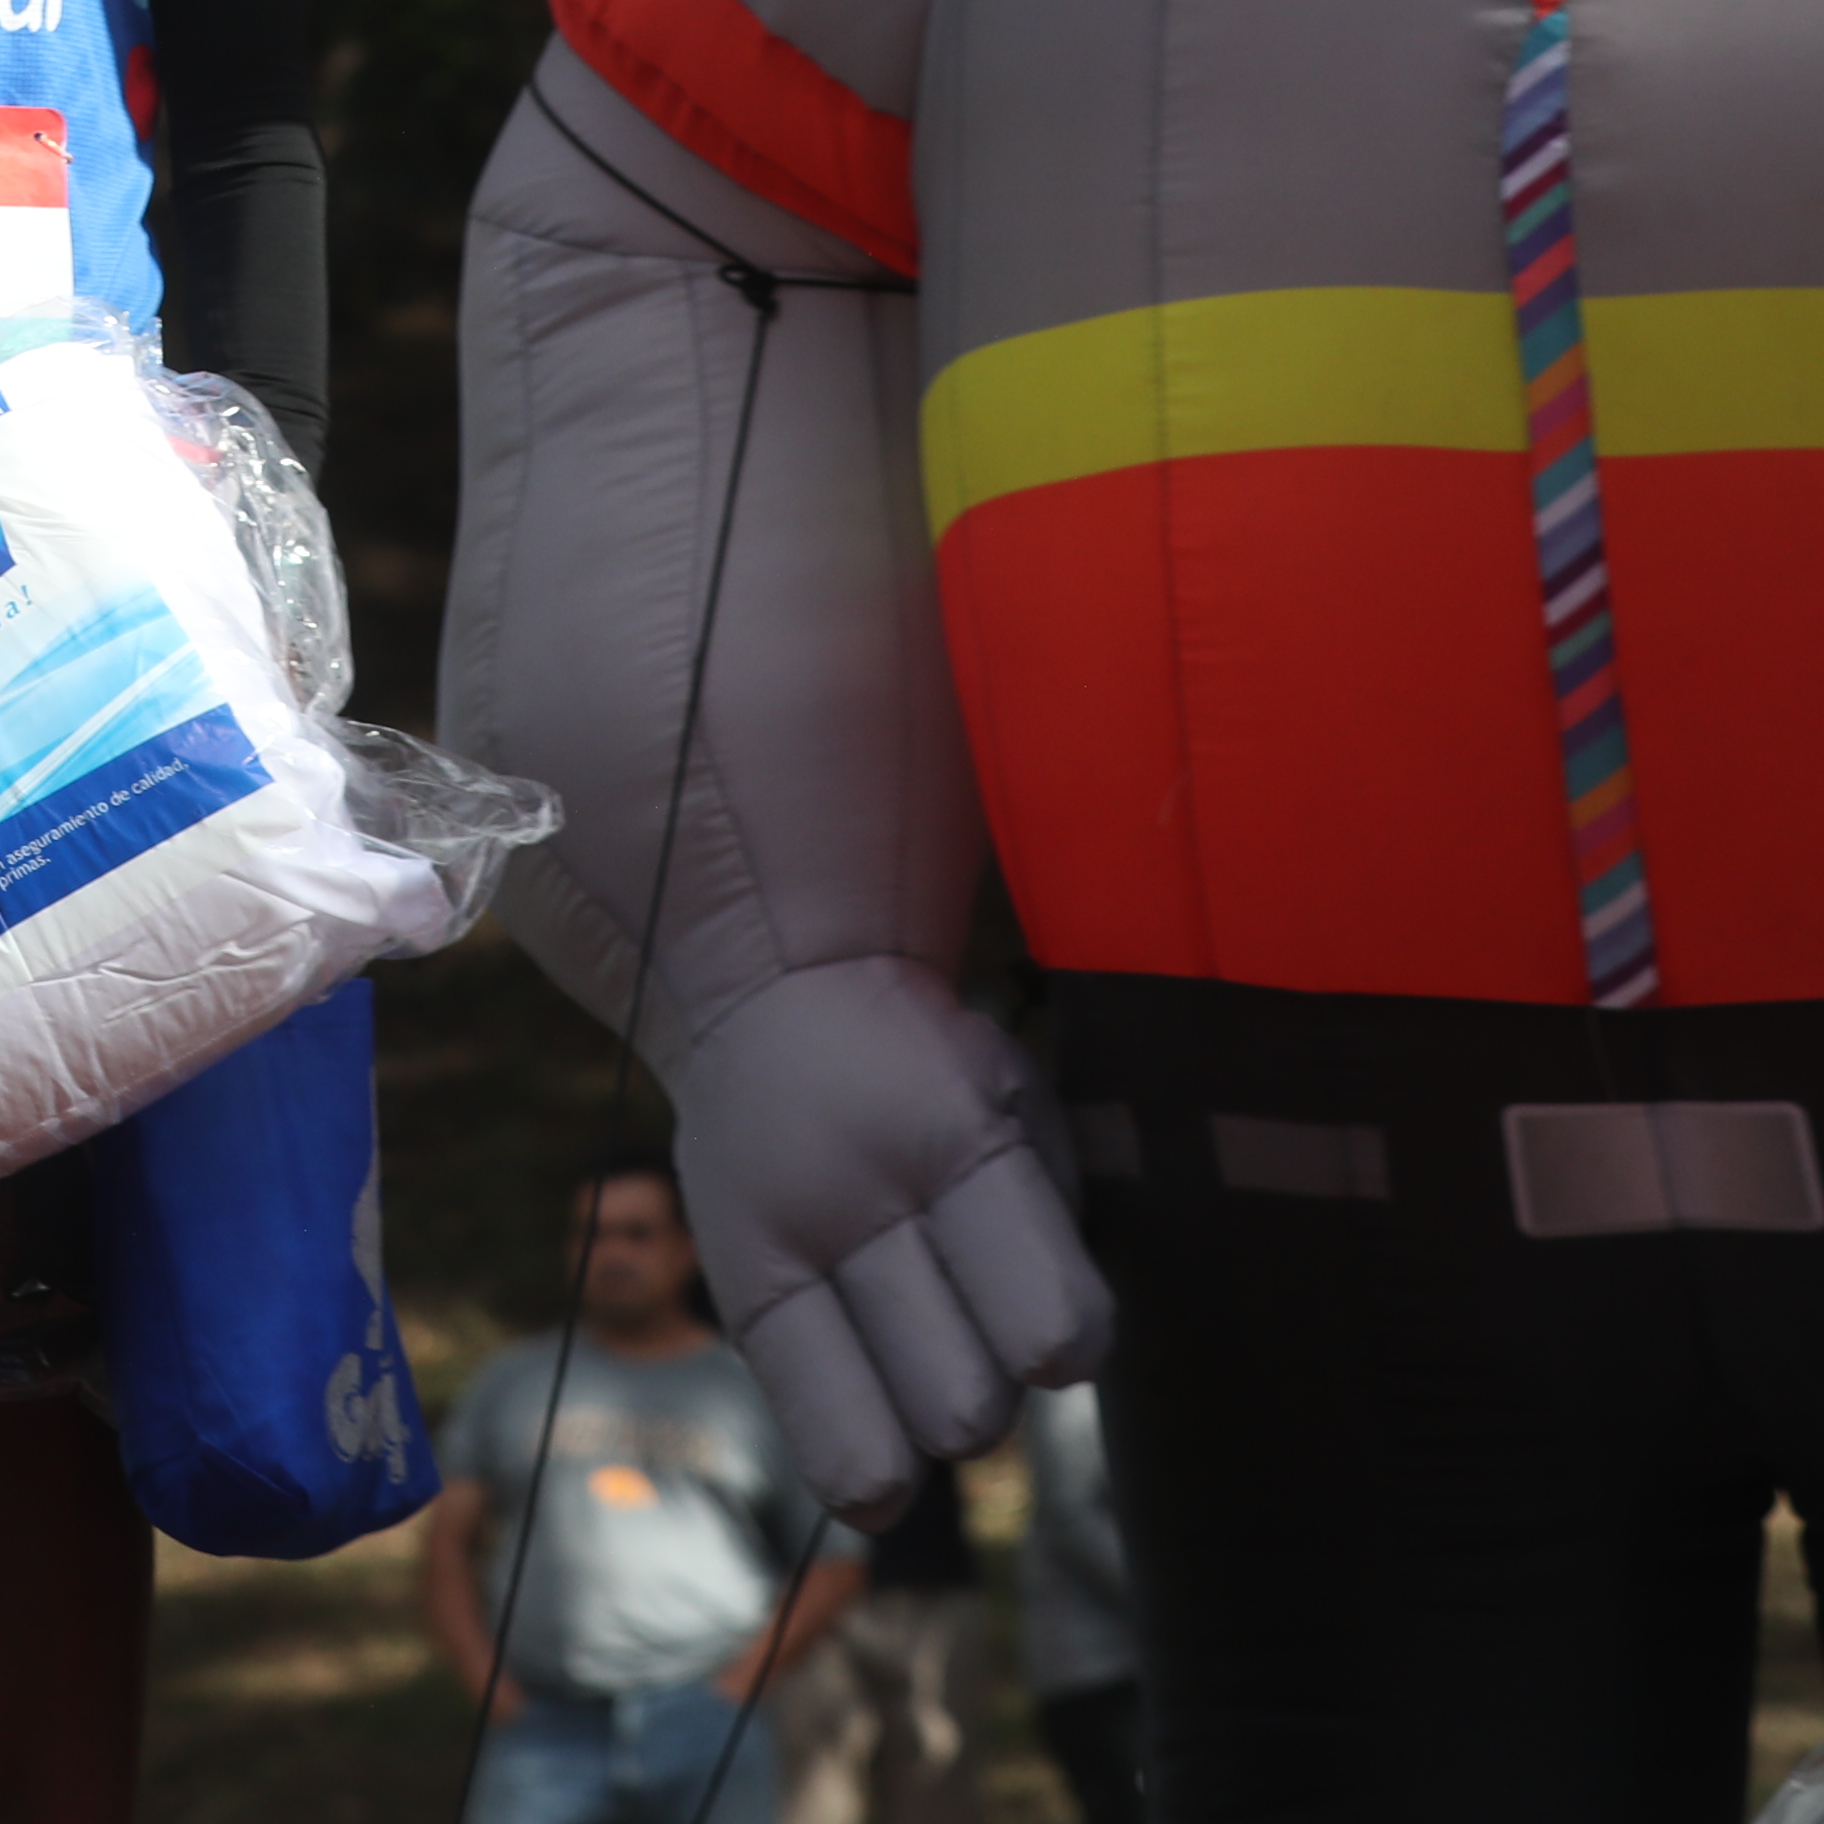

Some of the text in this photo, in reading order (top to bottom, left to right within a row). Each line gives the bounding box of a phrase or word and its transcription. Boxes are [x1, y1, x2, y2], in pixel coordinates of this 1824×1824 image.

[6, 800, 109, 865] aseguramiento
[109, 788, 132, 807] de
[131, 757, 190, 795] calidad,
